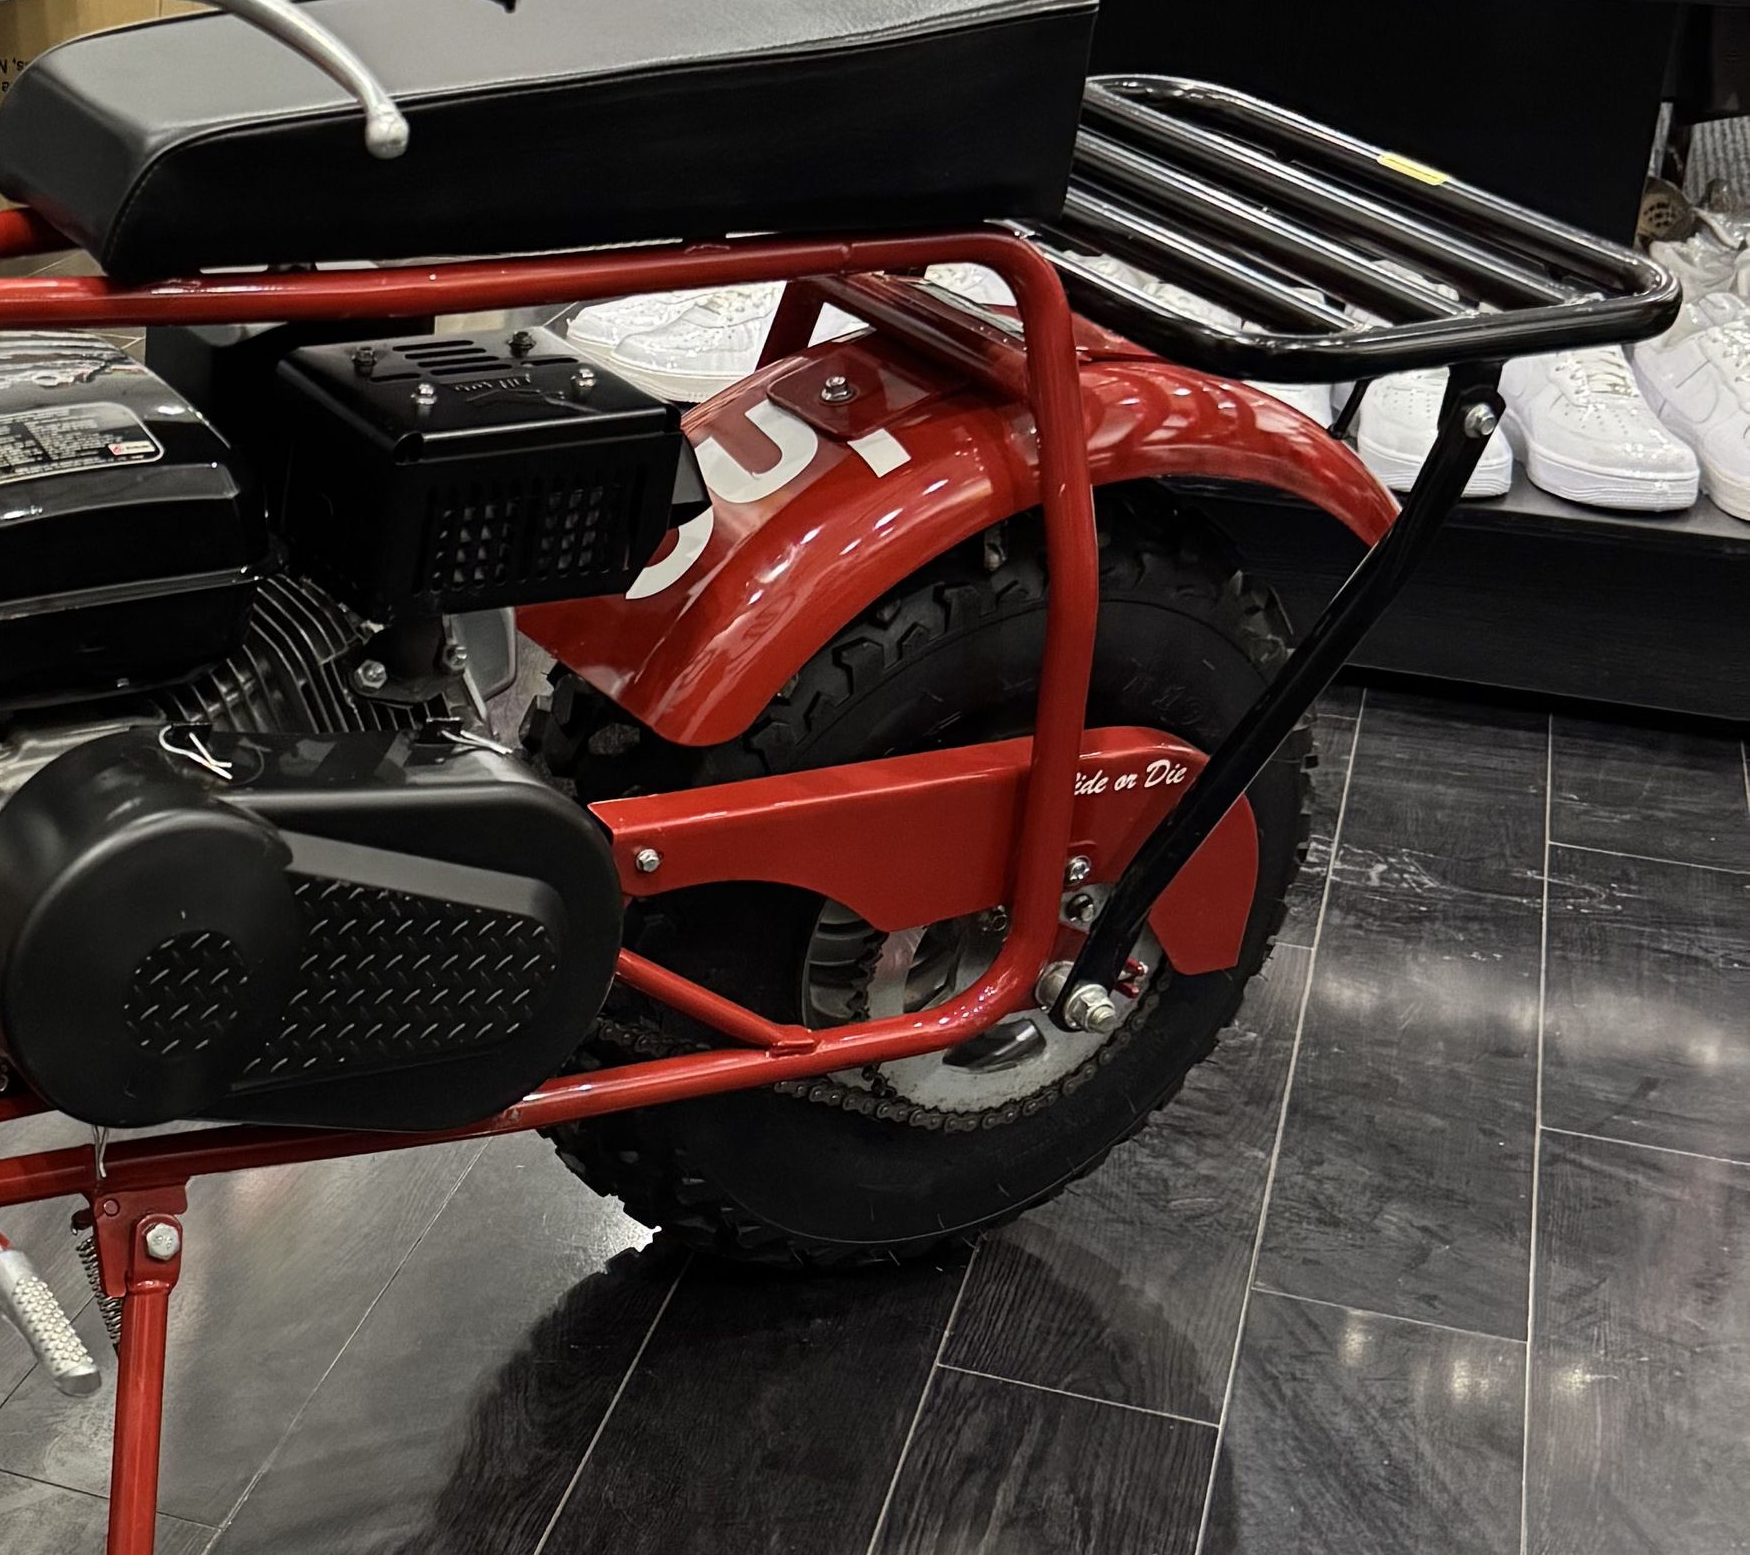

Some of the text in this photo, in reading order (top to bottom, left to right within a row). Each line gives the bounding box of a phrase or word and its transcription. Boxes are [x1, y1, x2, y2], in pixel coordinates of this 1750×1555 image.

[1073, 758, 1188, 796] ide or Die
